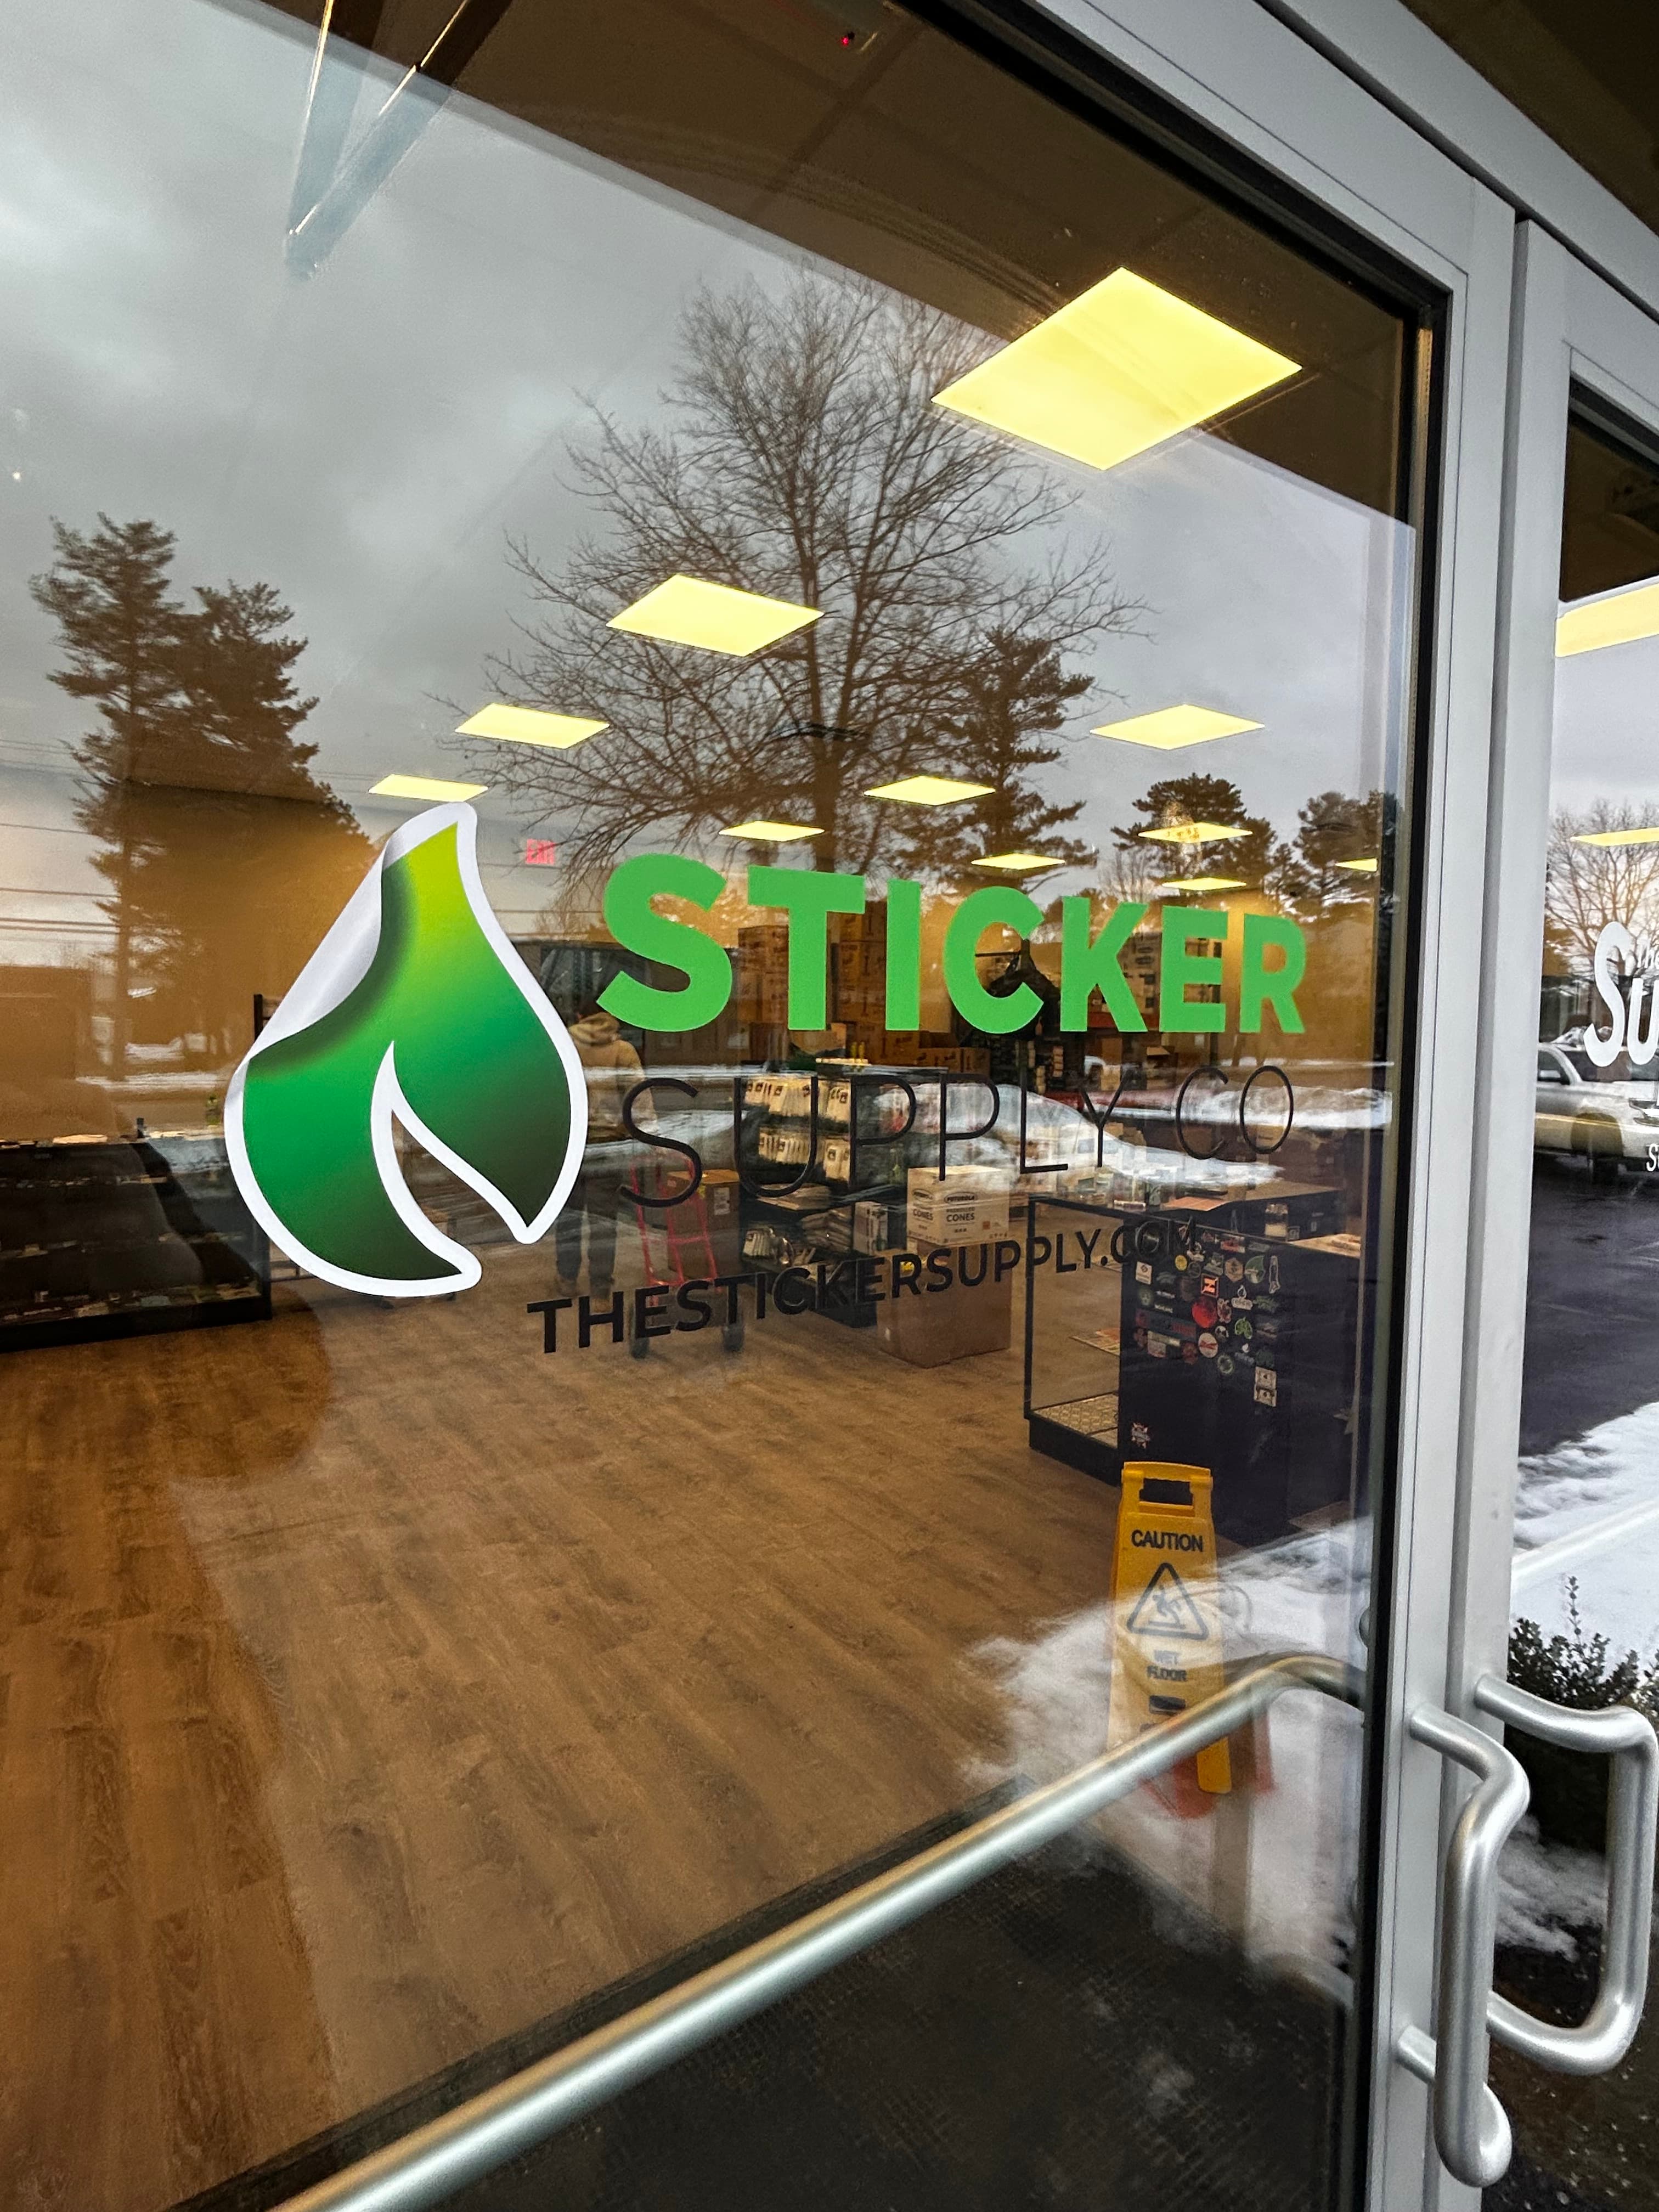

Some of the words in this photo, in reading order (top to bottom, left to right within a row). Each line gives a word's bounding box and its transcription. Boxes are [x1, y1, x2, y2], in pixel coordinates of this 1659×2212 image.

[596, 853, 1307, 1034] STICKER
[619, 1064, 1135, 1208] SUPPLY
[1175, 1065, 1294, 1160] CO
[946, 1212, 975, 1222] CONES
[527, 1214, 1197, 1353] THESTICKERSUPPLY.COM
[1131, 1529, 1204, 1553] CAUTION
[1147, 1665, 1187, 1681] FLOOR
